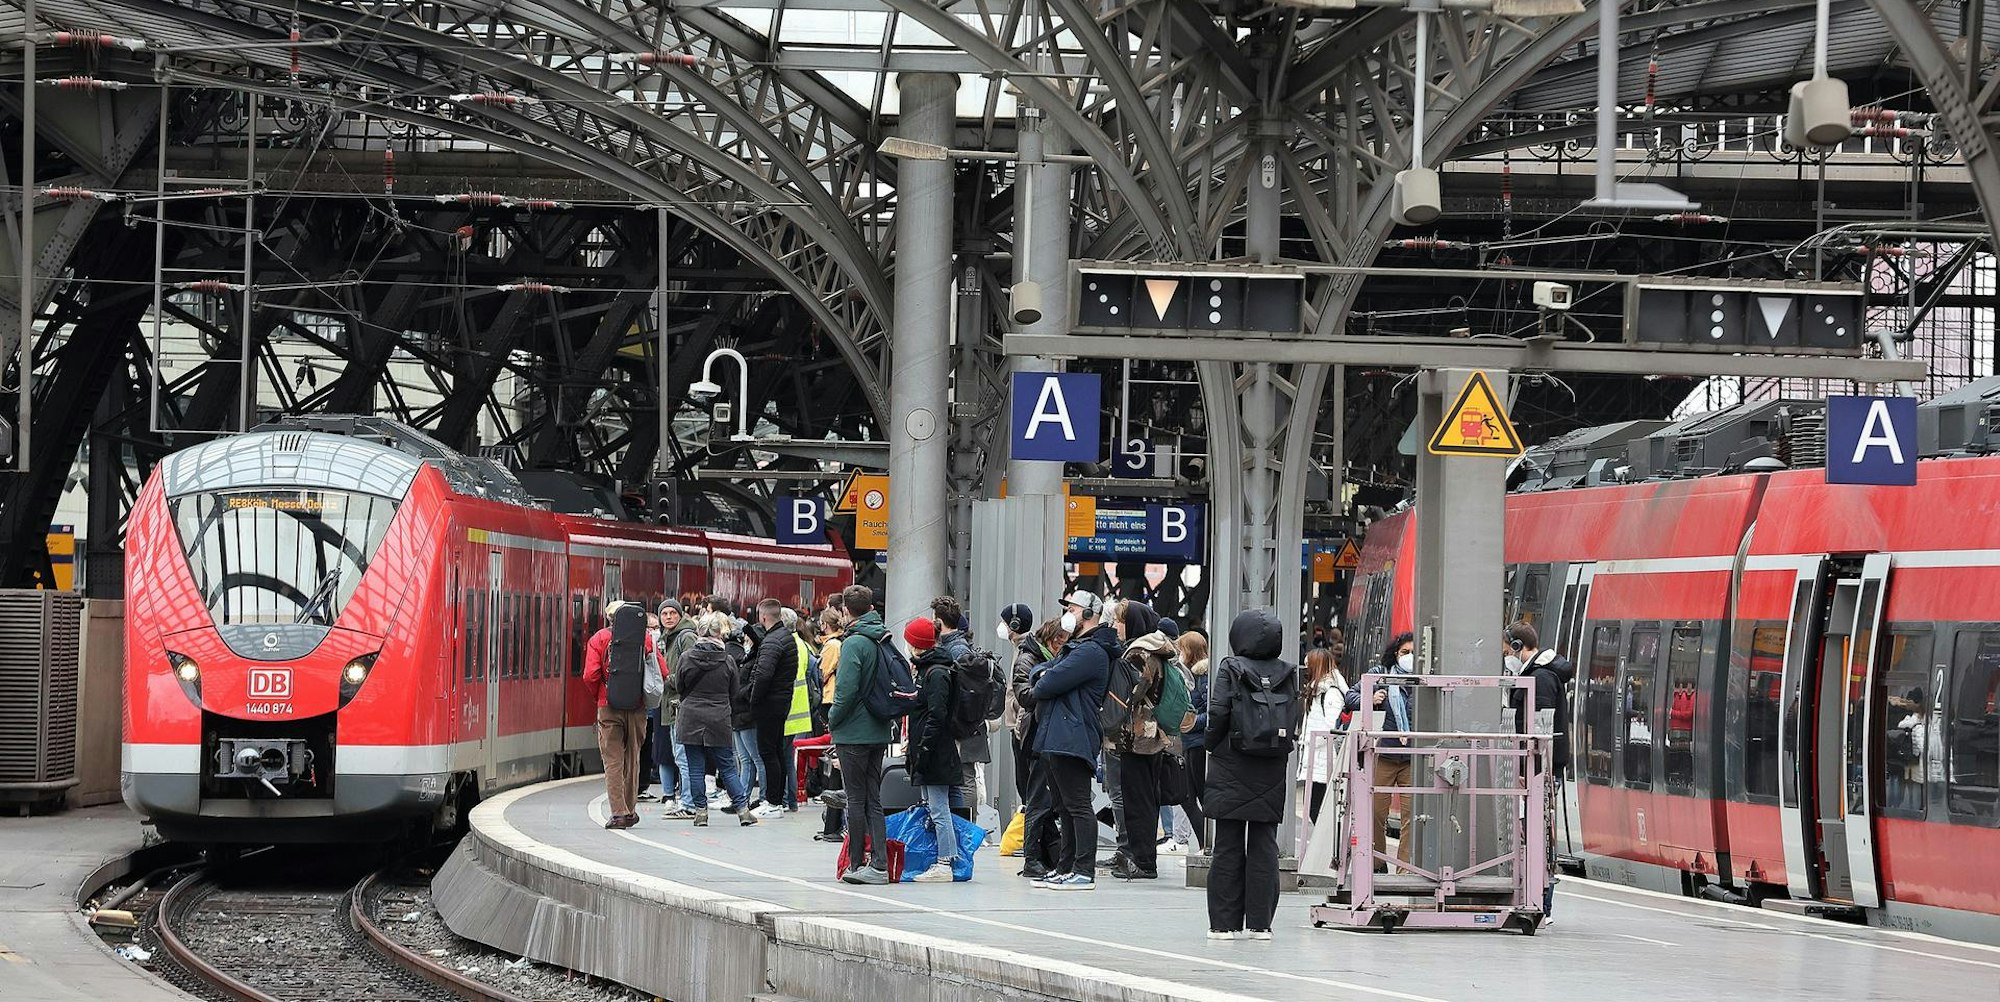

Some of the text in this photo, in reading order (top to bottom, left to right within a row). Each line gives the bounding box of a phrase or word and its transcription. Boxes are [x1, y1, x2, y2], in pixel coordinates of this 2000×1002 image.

[1025, 377, 1076, 441] A
[1852, 401, 1904, 464] A
[1126, 438, 1146, 470] 3
[793, 499, 818, 534] B
[1162, 507, 1187, 543] B
[253, 672, 287, 693] DB
[1934, 668, 1944, 708] 2
[246, 702, 293, 715] 1440 874
